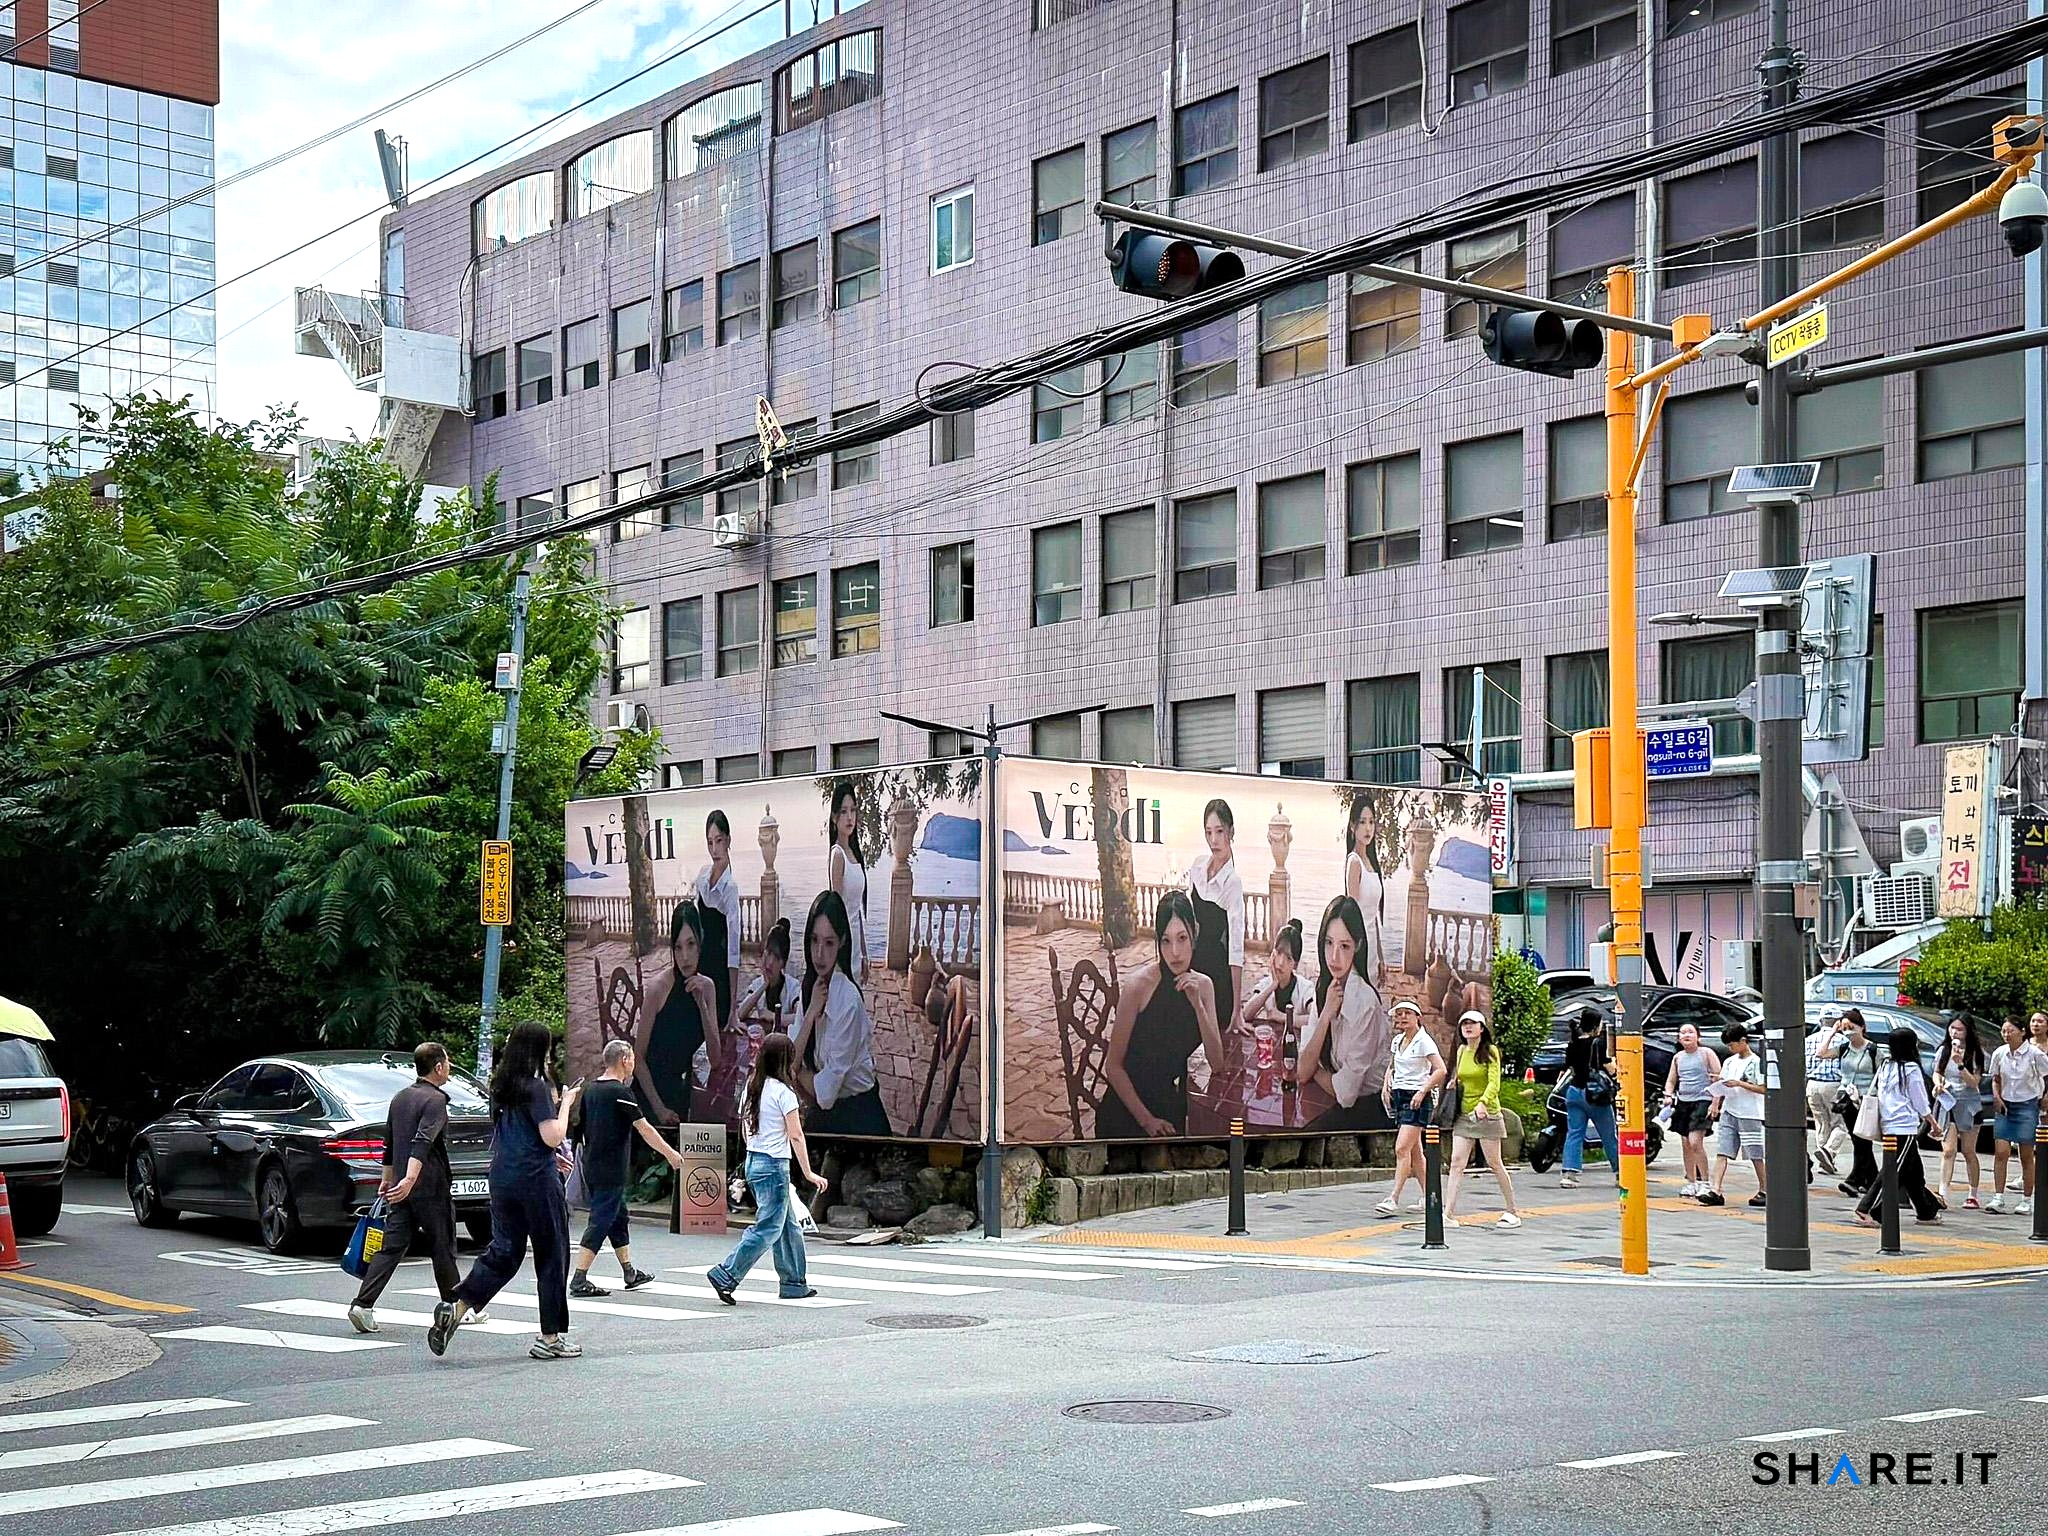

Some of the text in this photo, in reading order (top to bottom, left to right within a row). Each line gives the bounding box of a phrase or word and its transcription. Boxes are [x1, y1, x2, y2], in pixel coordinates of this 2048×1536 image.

[1773, 329, 1798, 354] CCTV
[1688, 747, 1708, 760] 6-gil
[1949, 773, 1978, 794] 토끼
[1965, 806, 1976, 819] 와
[1489, 782, 1507, 871] 유료주차장
[2023, 824, 2048, 847] 스
[1947, 833, 1976, 853] 거북
[1948, 859, 1970, 891] 전
[696, 1132, 710, 1141] NO
[684, 1143, 722, 1153] PARKING
[461, 1181, 487, 1193] 1602
